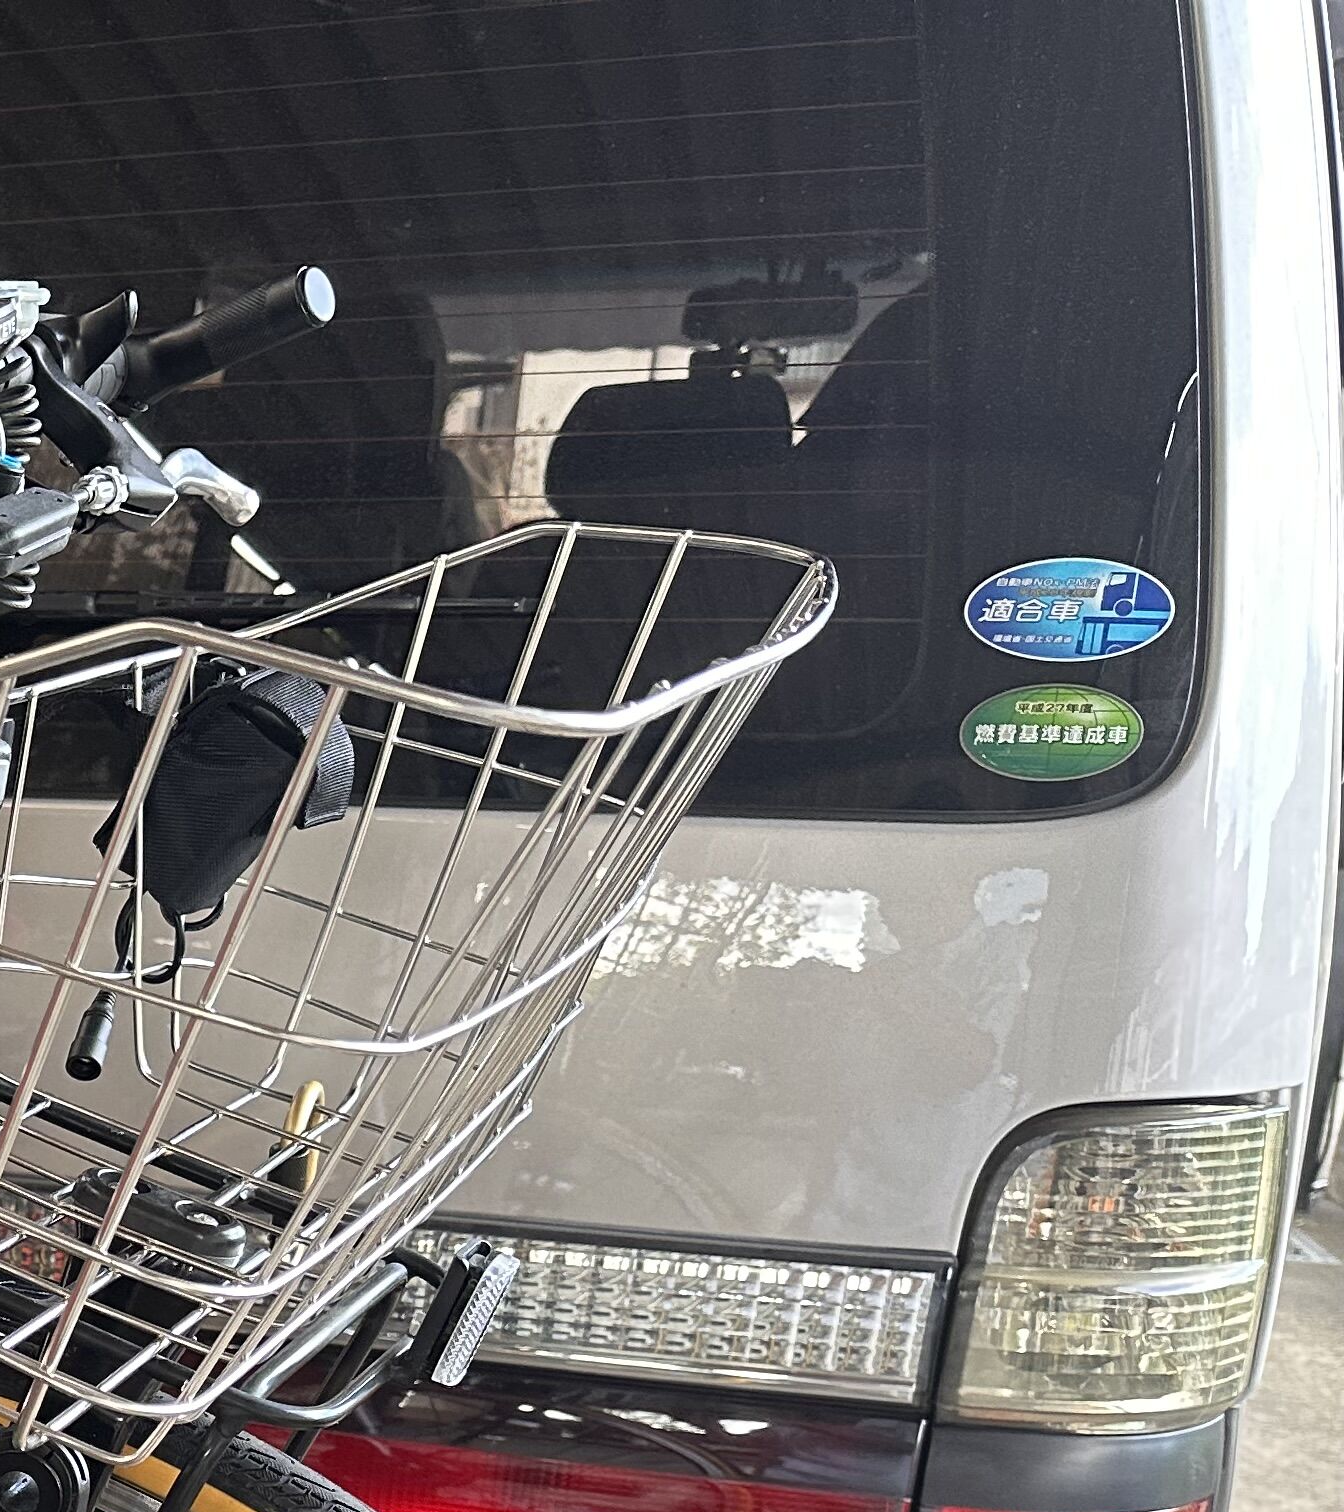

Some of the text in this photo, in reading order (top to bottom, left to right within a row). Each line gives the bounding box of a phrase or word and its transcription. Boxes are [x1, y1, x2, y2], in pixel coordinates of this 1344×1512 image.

[977, 598, 1084, 624] 適合車
[1016, 701, 1094, 714] 平成27年度
[973, 723, 1130, 746] 燃費基準達成車
